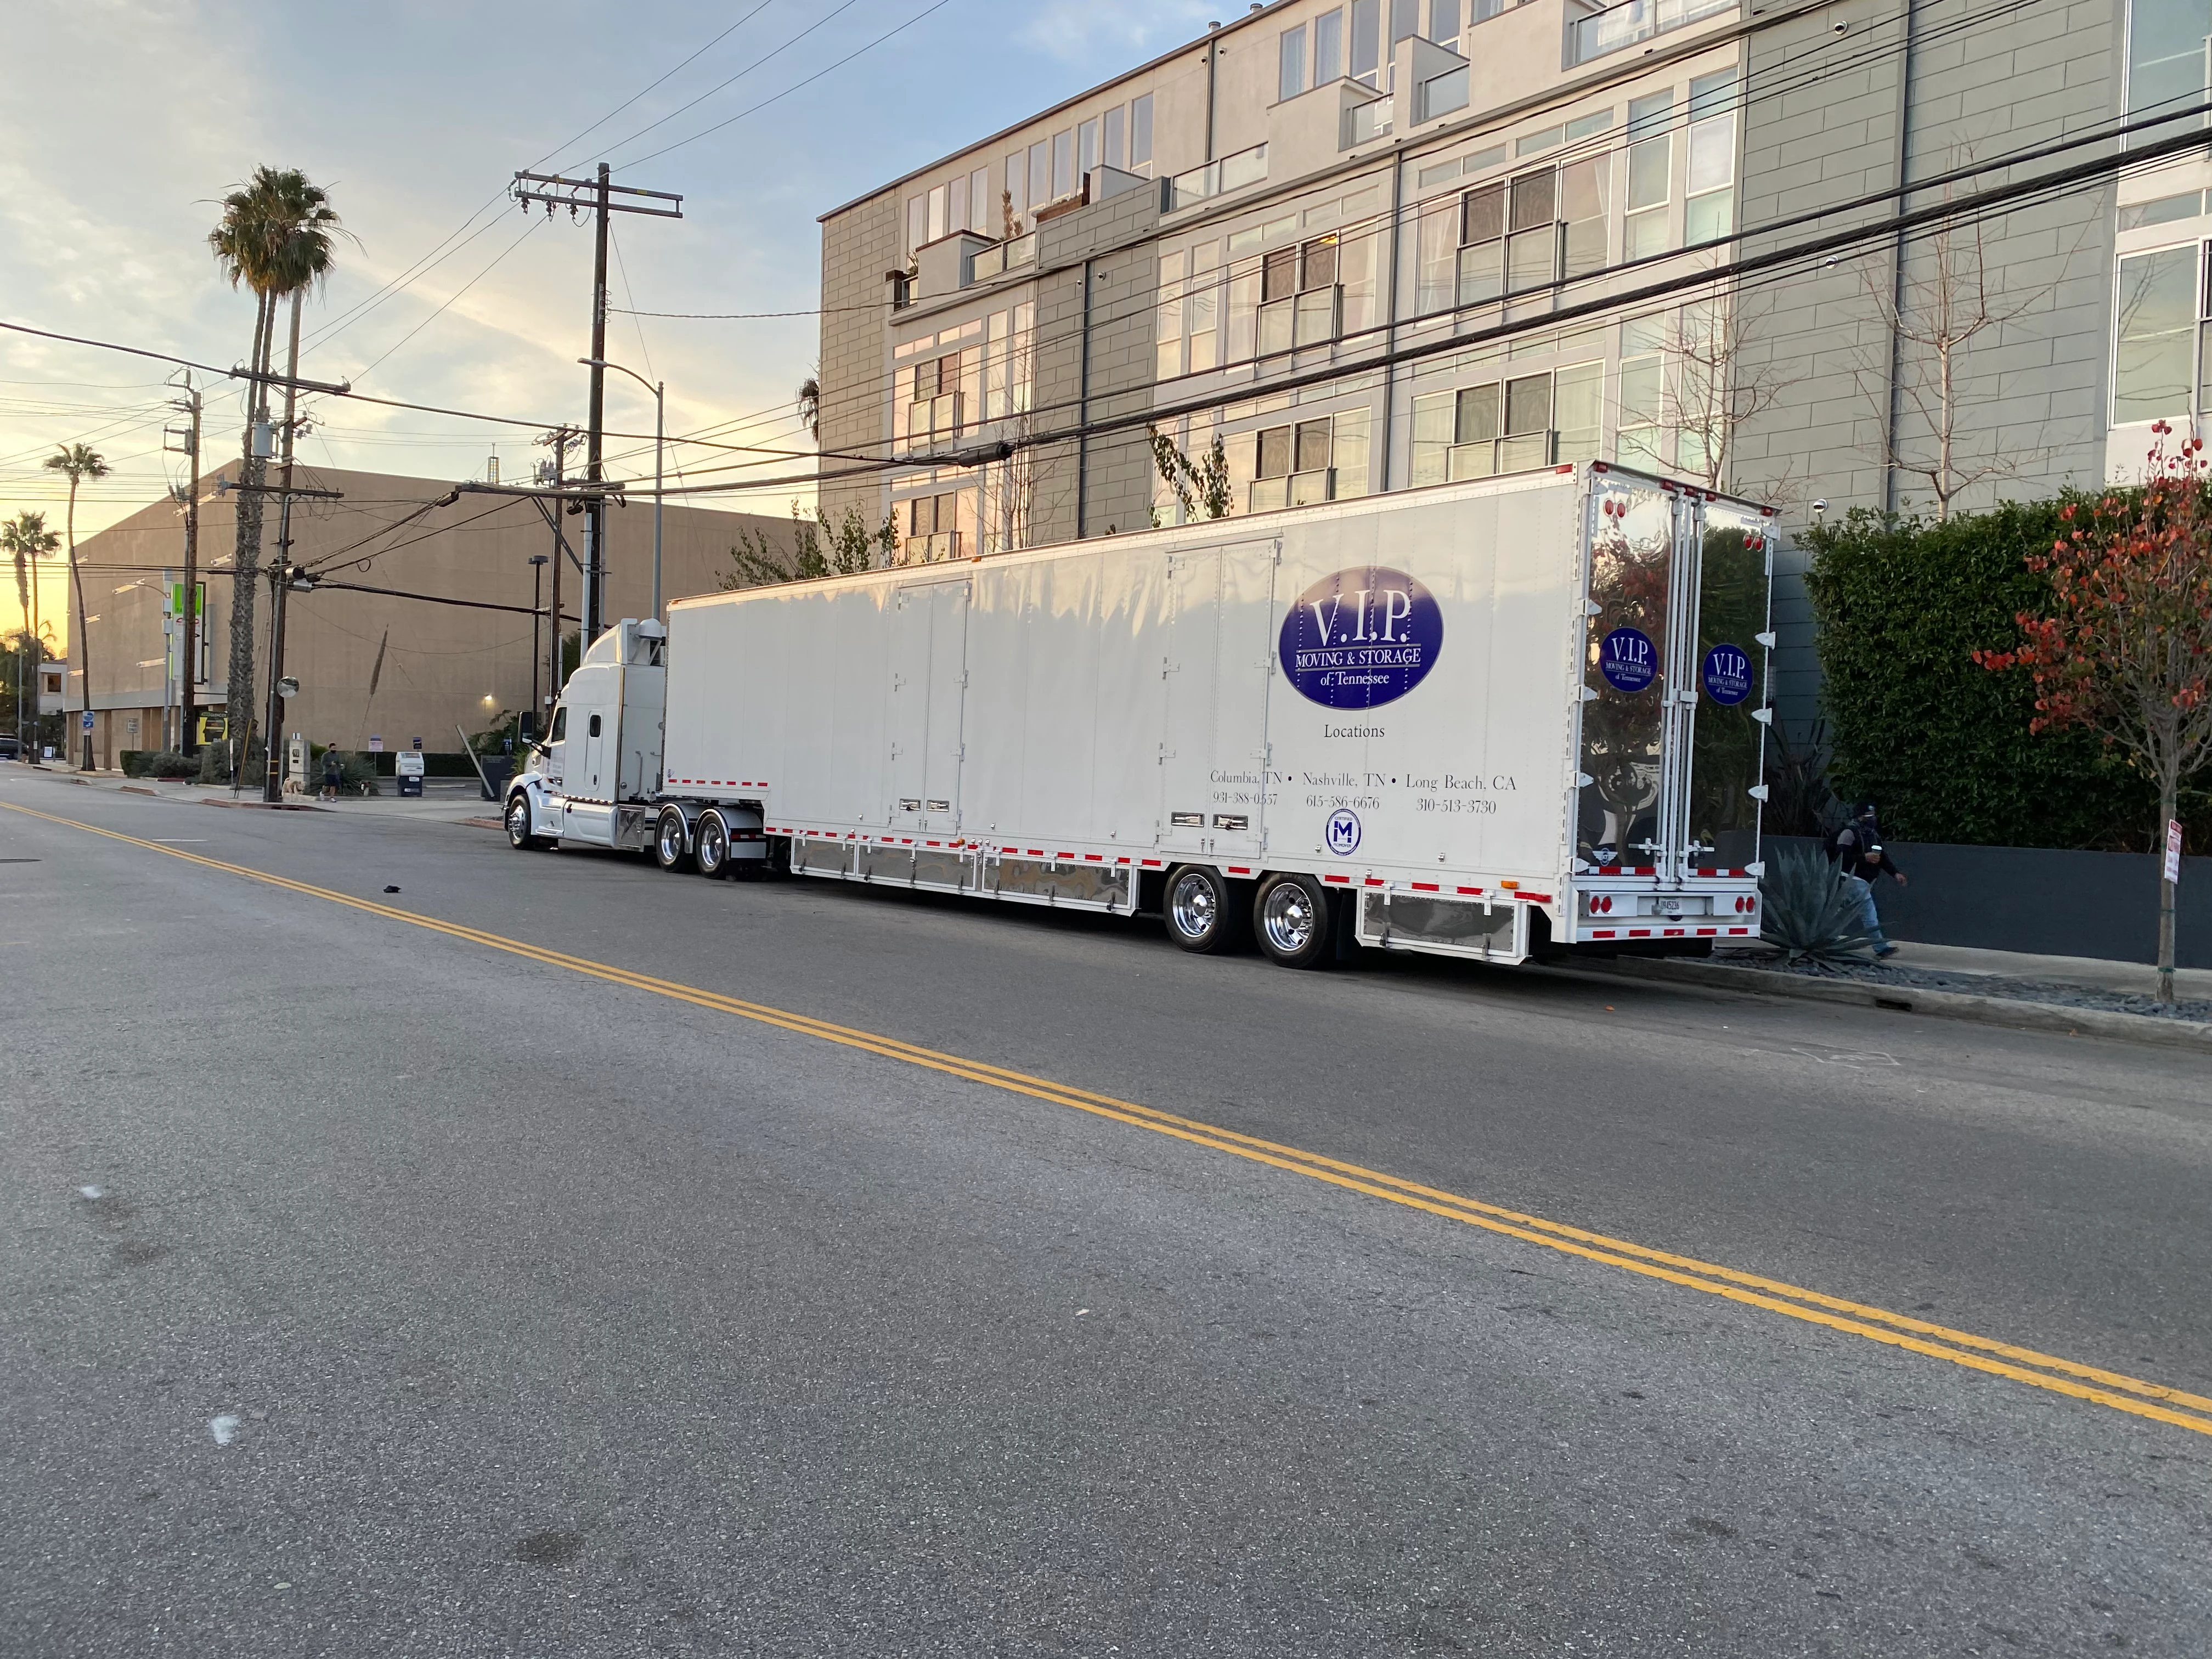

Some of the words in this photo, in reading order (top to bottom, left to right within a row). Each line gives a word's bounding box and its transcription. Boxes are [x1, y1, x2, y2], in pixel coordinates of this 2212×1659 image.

[1310, 589, 1411, 646] V.I.P.
[1295, 651, 1343, 668] MOVING
[1347, 652, 1355, 665] &
[1359, 648, 1421, 665] STORAGE
[1611, 637, 1648, 665] V.I.P.
[1606, 662, 1624, 671] MOVING
[1629, 665, 1651, 675] STORAGE
[1713, 653, 1745, 680] V.I.P.
[1321, 672, 1333, 686] of
[1335, 671, 1390, 685] Tennessee
[1621, 673, 1641, 682] Tennessee
[1708, 676, 1725, 685] MOVING
[1729, 680, 1747, 689] STORAGE
[1324, 724, 1385, 738] Locations
[1210, 770, 1260, 784] Columbia,
[1262, 771, 1283, 785] TN
[1303, 772, 1358, 788] Nashville,
[1363, 773, 1386, 787] TN
[1406, 774, 1438, 792] Long
[1444, 774, 1486, 791] Beach,
[1493, 775, 1517, 791] CA
[1213, 791, 1278, 805] 931-388-0557
[1306, 794, 1380, 809] 615-586-6676
[1416, 798, 1496, 814] 310-513-3730
